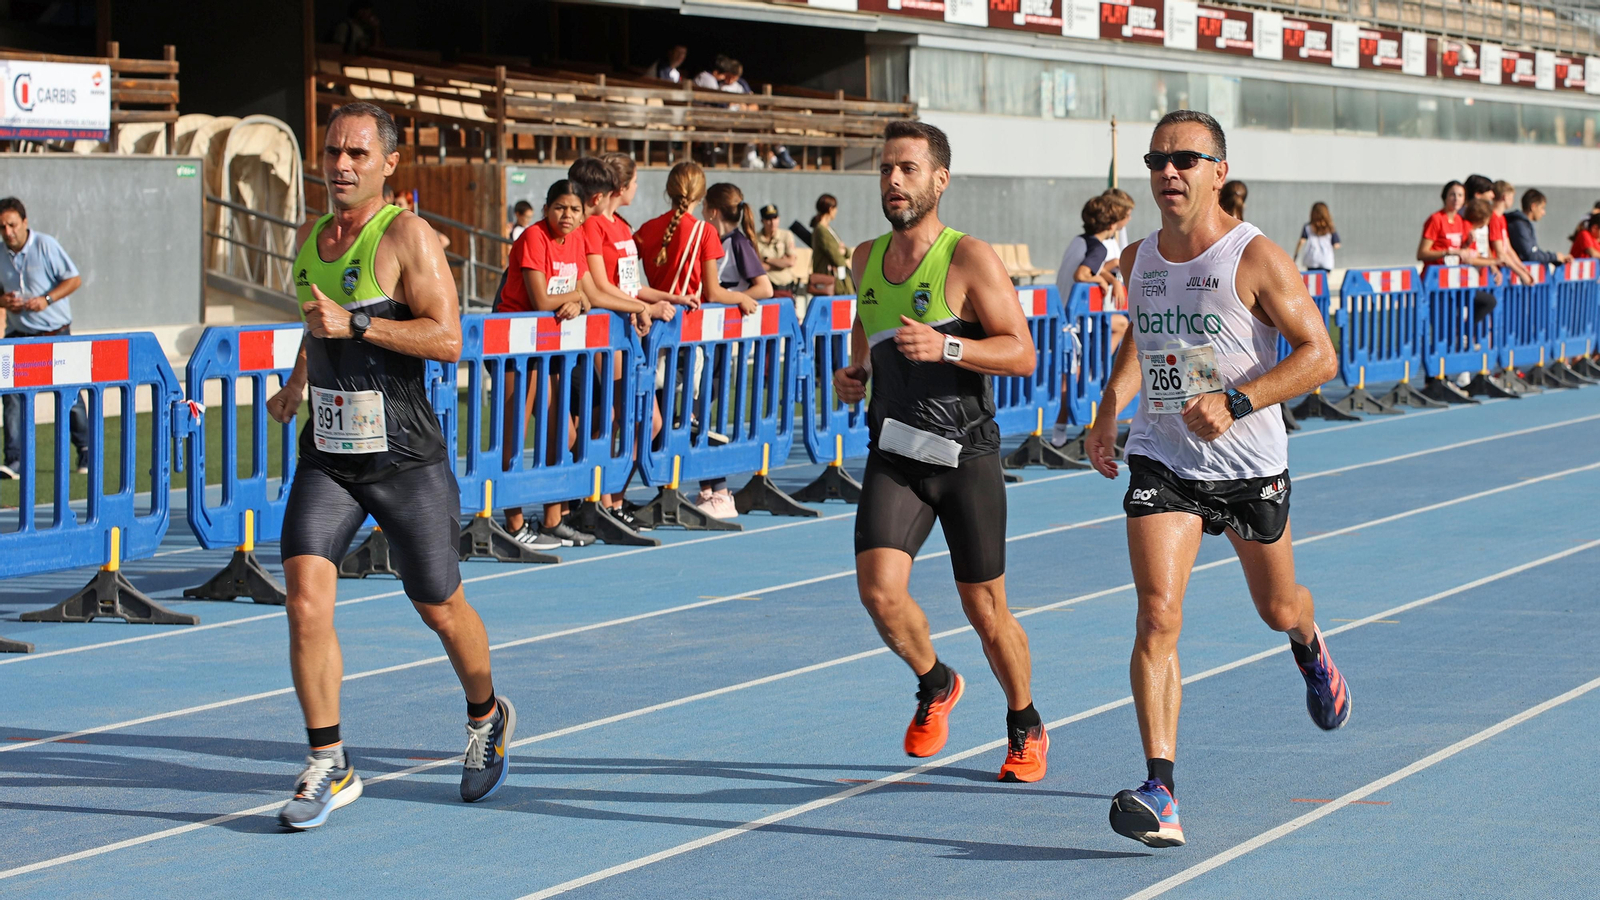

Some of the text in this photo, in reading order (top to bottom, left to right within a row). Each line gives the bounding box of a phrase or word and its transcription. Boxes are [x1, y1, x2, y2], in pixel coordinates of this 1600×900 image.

[37, 88, 76, 104] CARBIS
[1143, 269, 1168, 279] bathco
[1142, 278, 1166, 286] running
[1186, 275, 1219, 289] JULIÁN
[1141, 285, 1167, 297] TEAM
[1136, 305, 1222, 335] bathco
[1149, 367, 1182, 391] 266
[318, 405, 343, 431] 891
